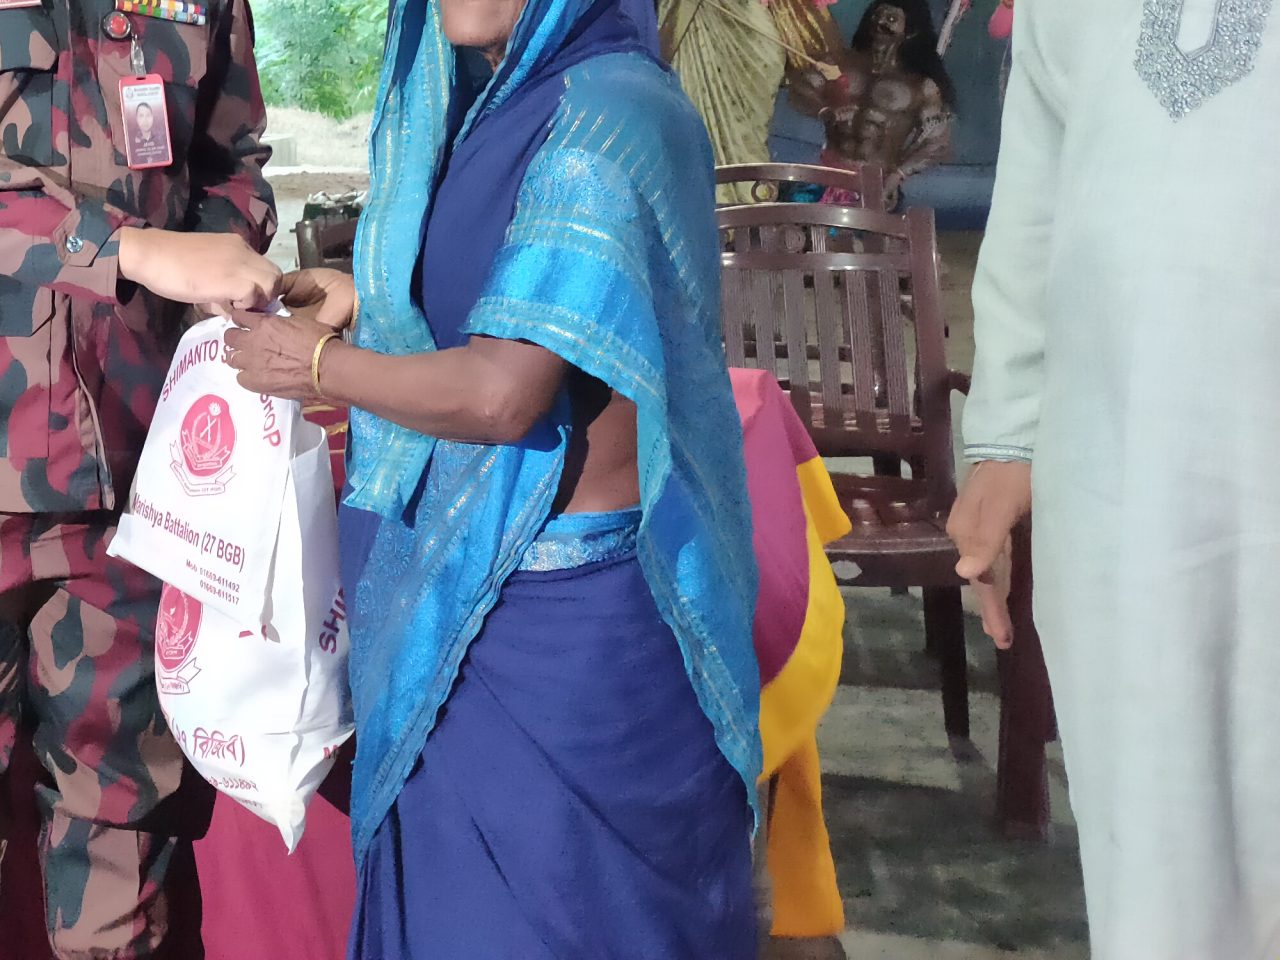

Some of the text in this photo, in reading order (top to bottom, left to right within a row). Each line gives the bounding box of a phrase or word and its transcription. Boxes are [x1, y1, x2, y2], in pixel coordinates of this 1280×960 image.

[162, 339, 219, 402] SHIMANTO
[132, 492, 245, 573] Marishya Battalion (27 BGB)
